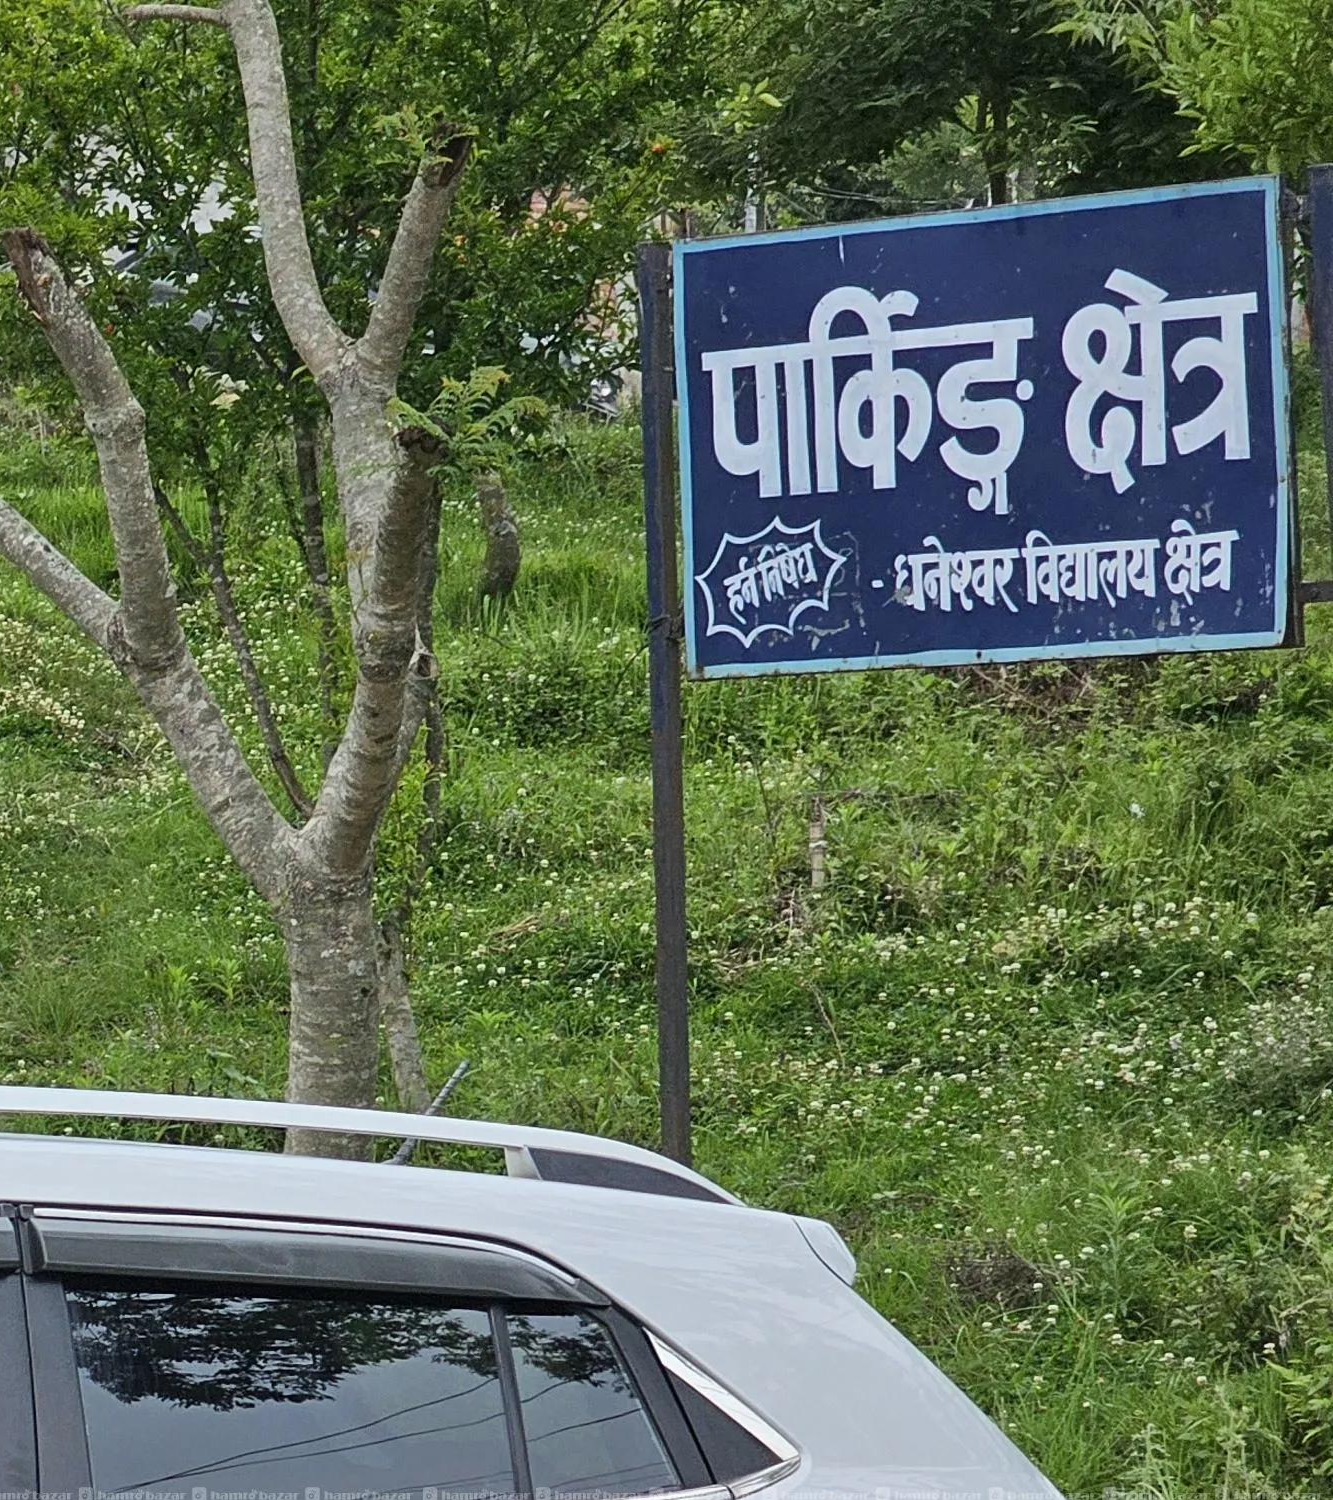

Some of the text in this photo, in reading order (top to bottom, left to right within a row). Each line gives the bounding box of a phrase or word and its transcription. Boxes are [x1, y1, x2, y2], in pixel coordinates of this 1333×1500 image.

[1061, 268, 1258, 494] क्षेत्र
[895, 535, 1020, 613] धनेश्वर
[1021, 530, 1161, 608] विद्यालय
[1164, 519, 1240, 606] क्षेत्र
